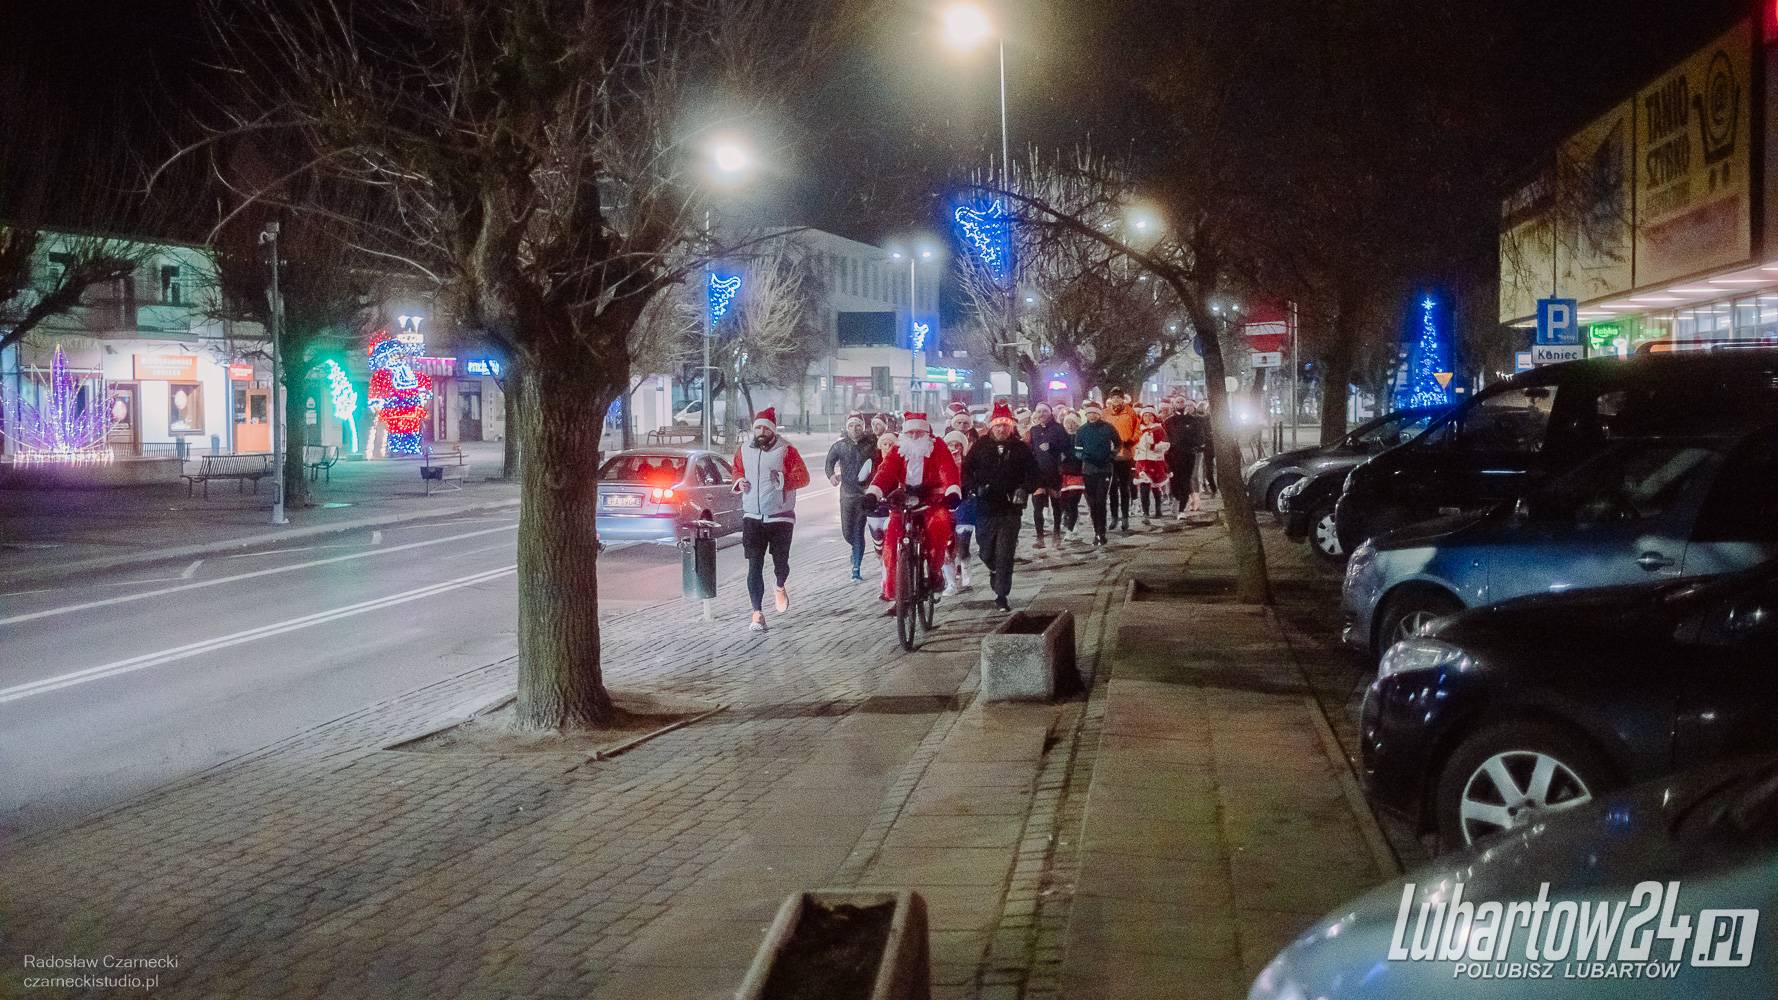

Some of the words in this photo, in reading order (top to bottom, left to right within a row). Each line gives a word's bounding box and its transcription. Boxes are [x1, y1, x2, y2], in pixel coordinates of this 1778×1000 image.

[1645, 74, 1689, 147] TANIO
[1646, 131, 1690, 189] SZYBKO
[1547, 304, 1570, 338] P
[1538, 349, 1578, 360] Koniec
